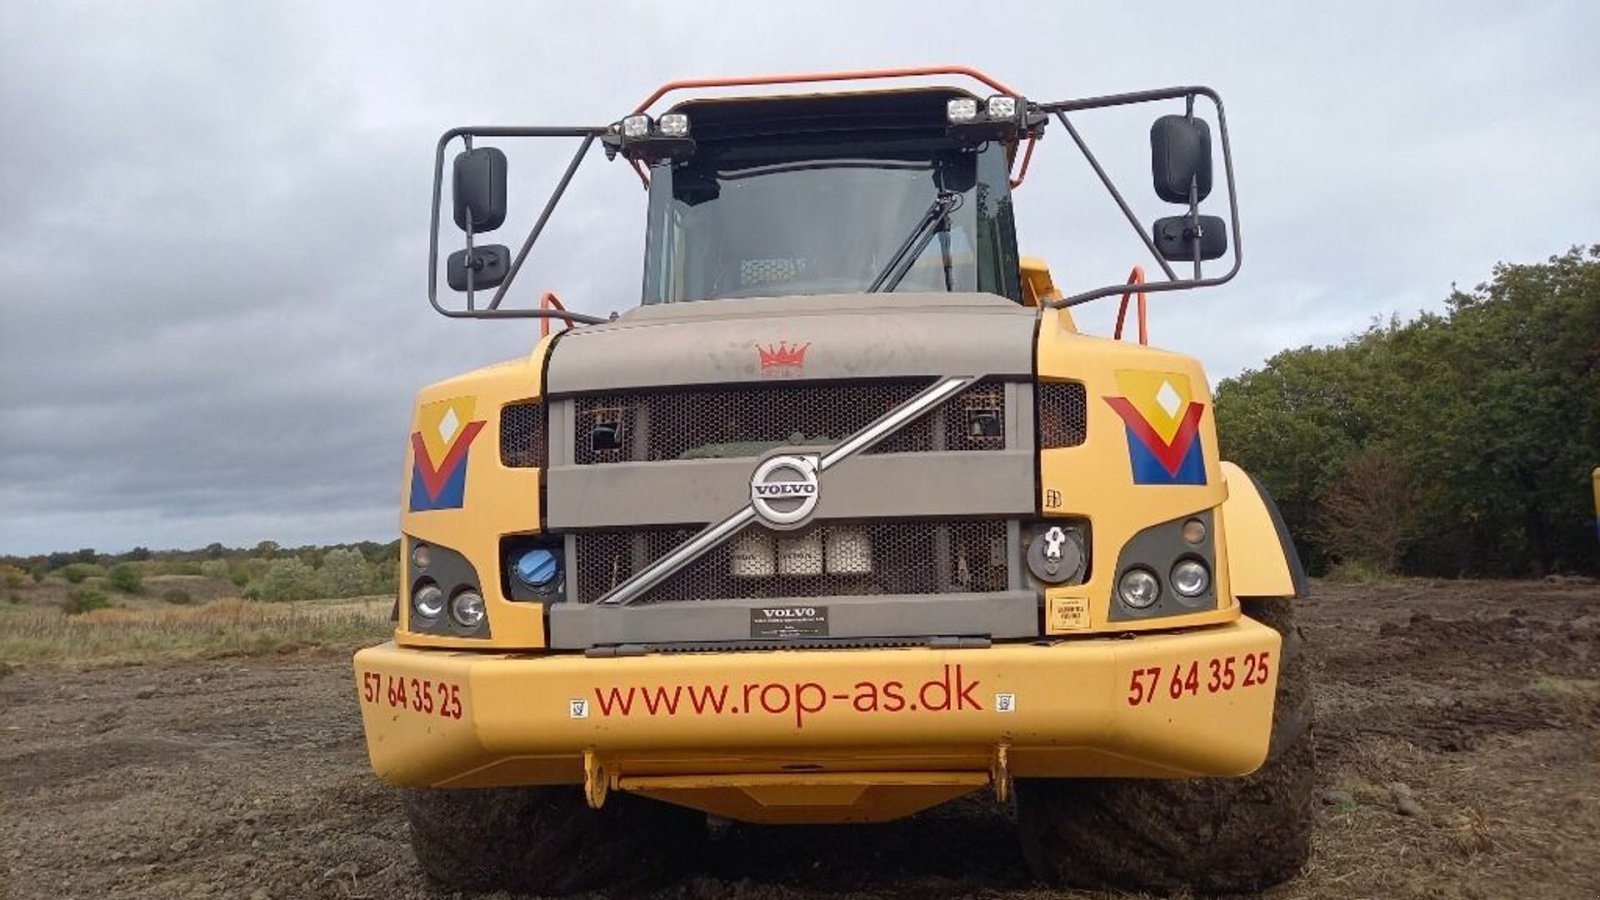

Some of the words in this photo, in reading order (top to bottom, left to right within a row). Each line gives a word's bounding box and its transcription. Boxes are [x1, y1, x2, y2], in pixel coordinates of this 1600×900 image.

[755, 484, 815, 494] VOLVO
[763, 608, 815, 617] VOLVO
[363, 672, 381, 703] 57
[387, 676, 407, 709] 64
[412, 679, 433, 714] 35
[438, 683, 462, 720] 25
[594, 664, 982, 728] www.rop-as.dk
[1128, 667, 1161, 706] 57
[1169, 661, 1200, 699] 64
[1207, 657, 1236, 693] 35
[1242, 652, 1270, 687] 25
